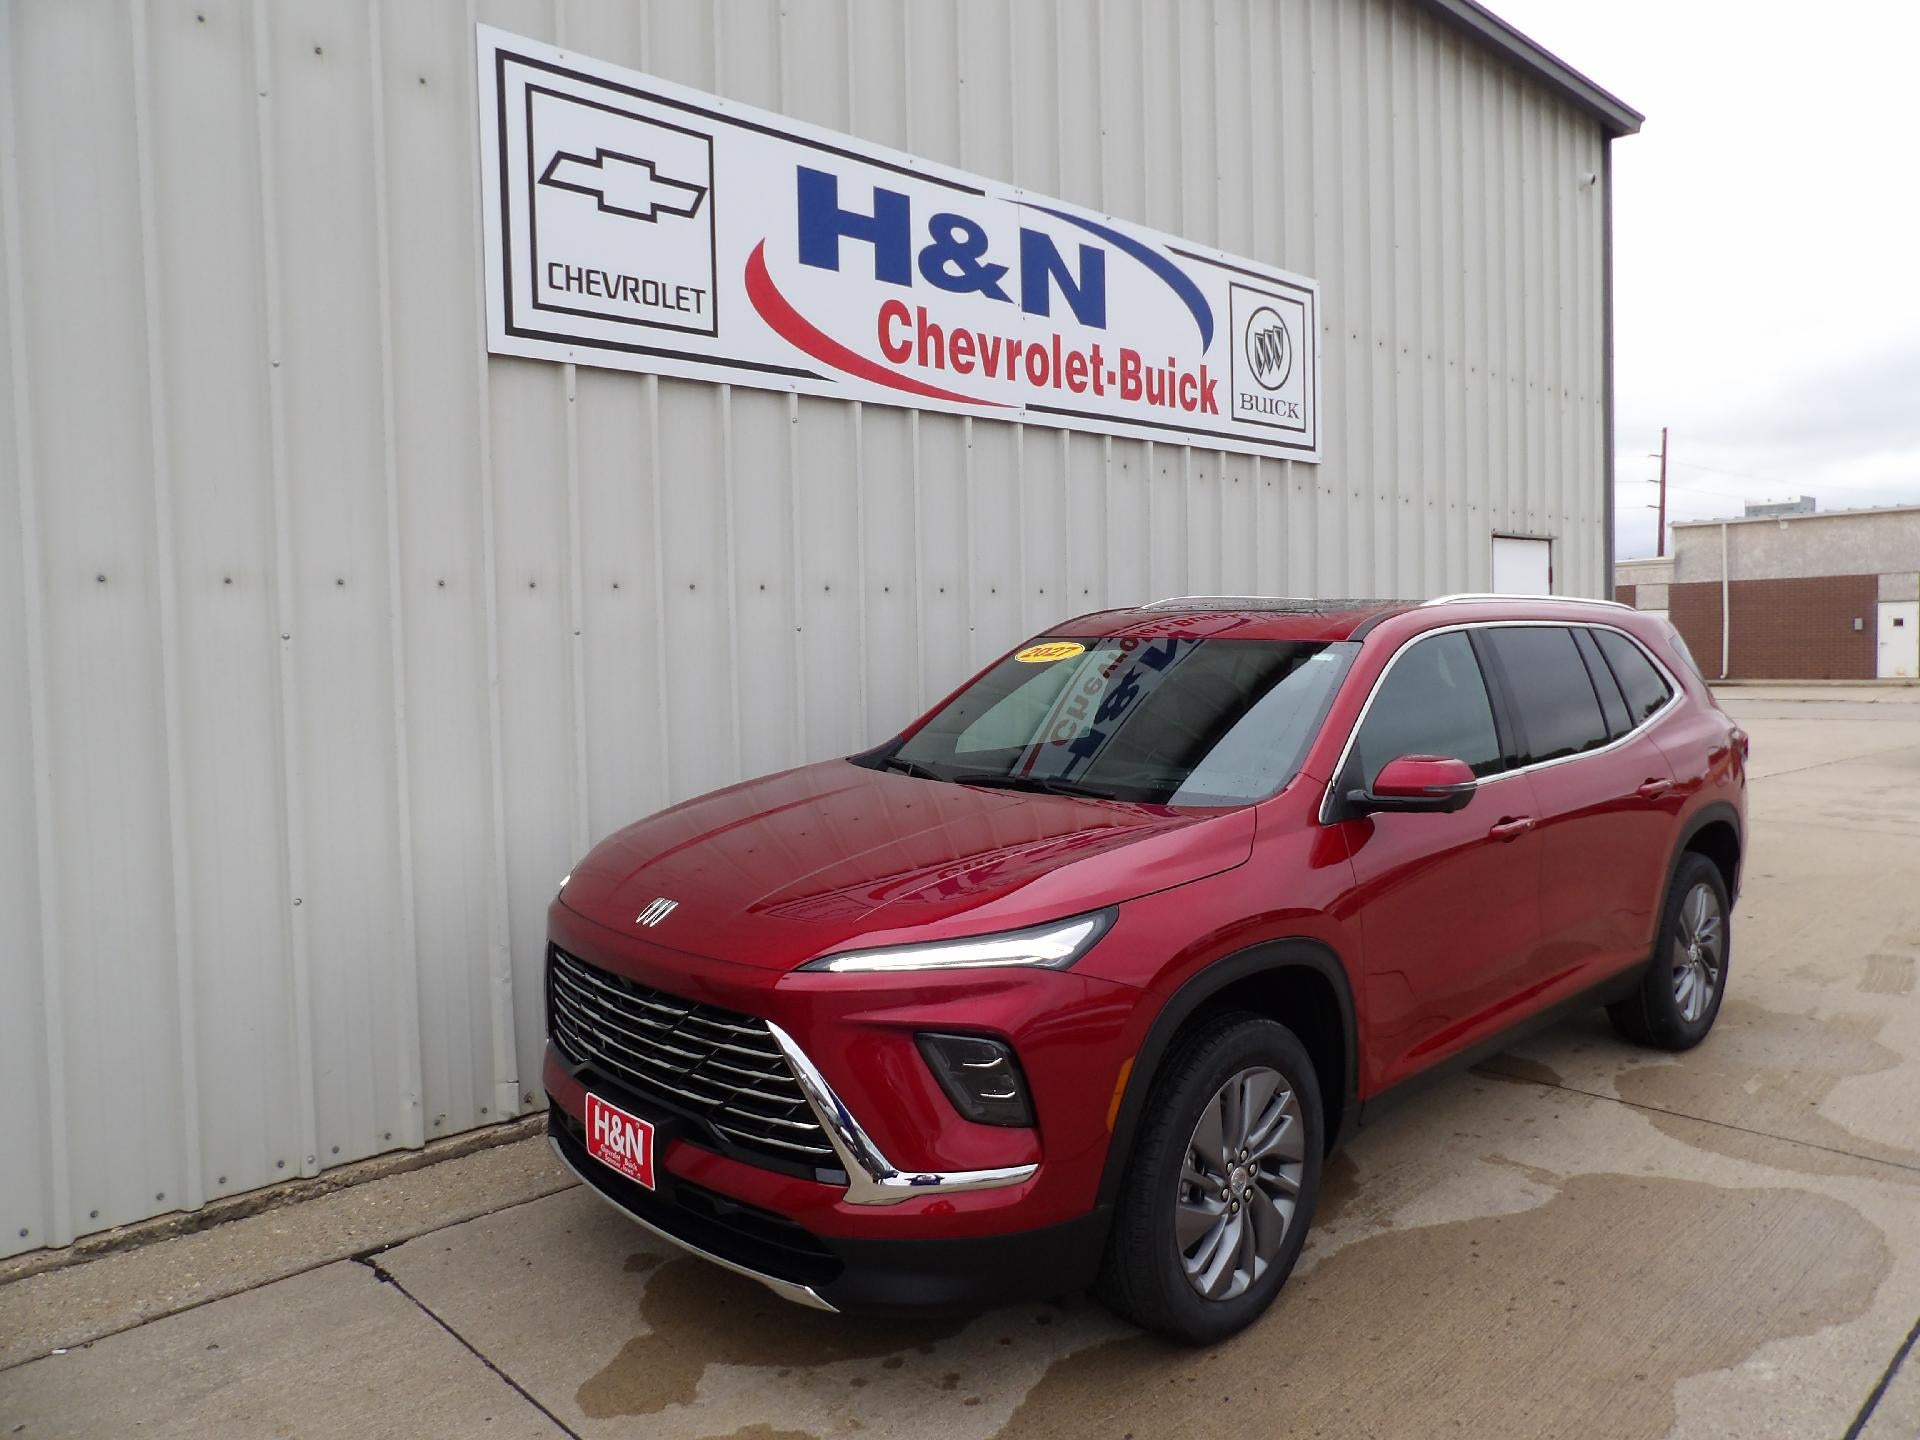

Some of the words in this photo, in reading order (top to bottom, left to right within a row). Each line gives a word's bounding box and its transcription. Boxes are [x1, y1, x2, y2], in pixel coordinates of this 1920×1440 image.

[797, 164, 1107, 330] H&N
[548, 262, 706, 314] CHEVROLET
[878, 299, 1219, 415] Chevrolet-Buick
[1240, 392, 1300, 419] BUICK
[1020, 646, 1081, 657] 2027
[594, 1104, 644, 1166] H&N
